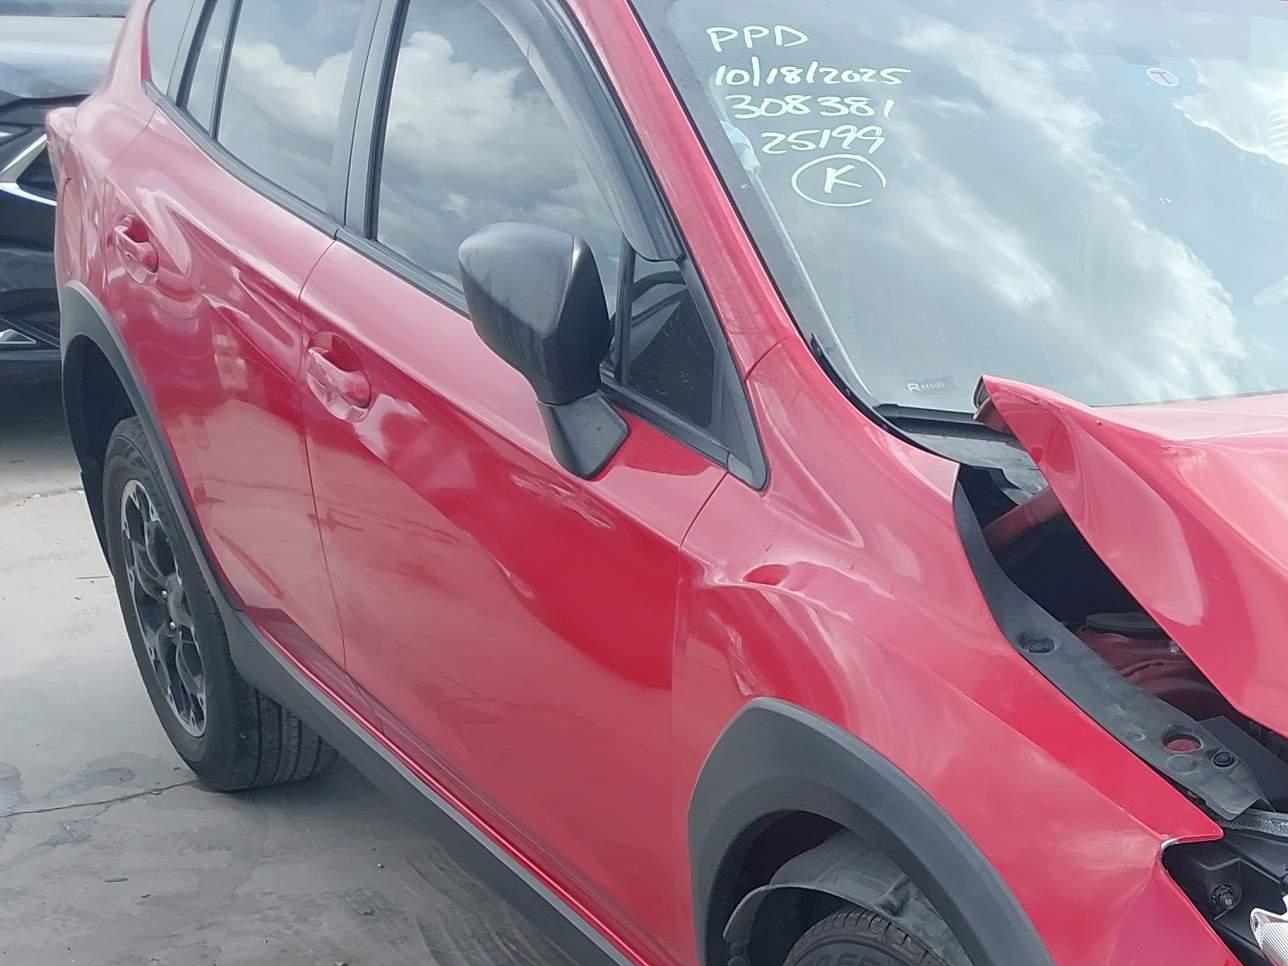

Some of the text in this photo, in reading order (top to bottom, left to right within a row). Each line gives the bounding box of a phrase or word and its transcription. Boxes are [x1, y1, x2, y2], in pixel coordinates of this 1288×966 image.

[705, 25, 809, 53] PPD
[714, 56, 912, 87] 10/18/2025
[725, 95, 895, 120] 308381
[760, 124, 886, 154] 25199
[823, 164, 863, 194] K
